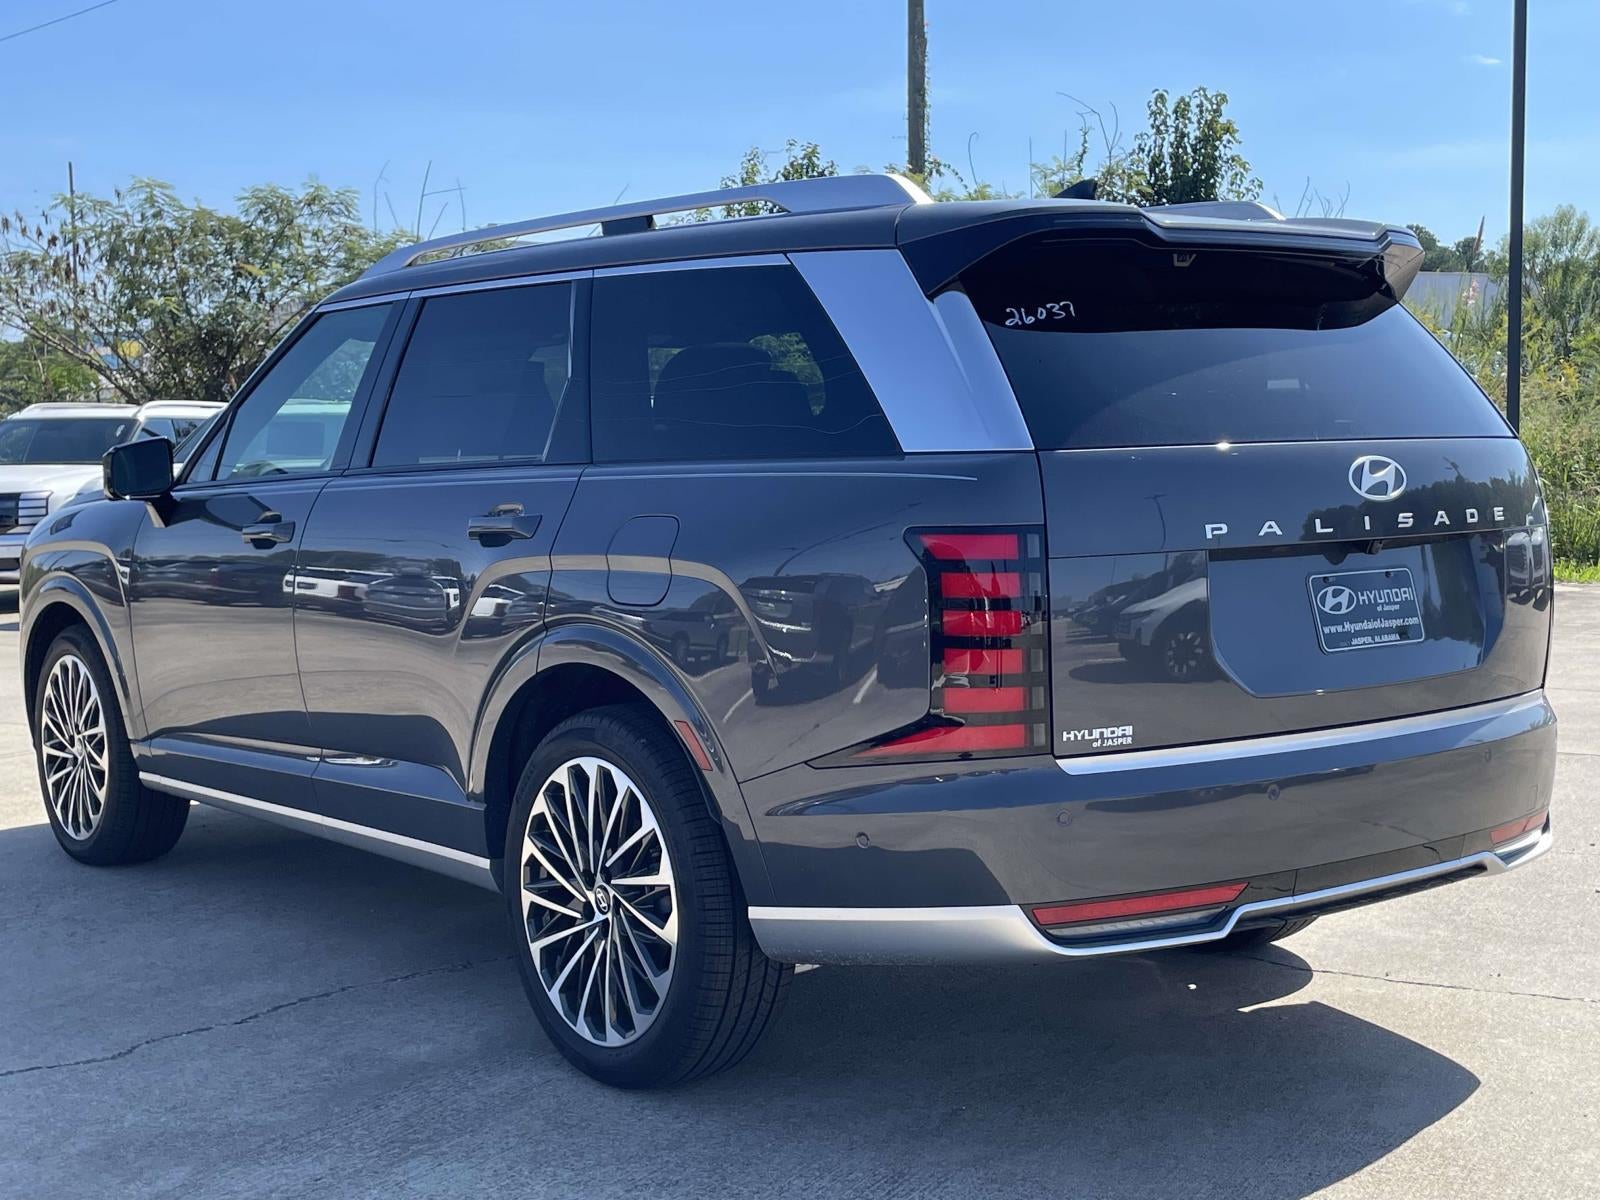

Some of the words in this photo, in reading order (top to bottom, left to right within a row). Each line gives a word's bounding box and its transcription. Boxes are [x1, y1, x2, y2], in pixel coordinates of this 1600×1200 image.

[1005, 301, 1075, 326] 26037
[1204, 506, 1505, 539] PALISADE
[1358, 587, 1414, 605] HYUNDAI
[1383, 604, 1400, 612] Jasper
[1322, 616, 1420, 634] www.HyundaiofJasper.com
[1351, 636, 1374, 646] JASPER,
[1374, 633, 1400, 643] ALABAMA
[1062, 725, 1133, 742] HYUNDAI
[1092, 738, 1101, 748] of
[1102, 736, 1132, 747] JASPER
